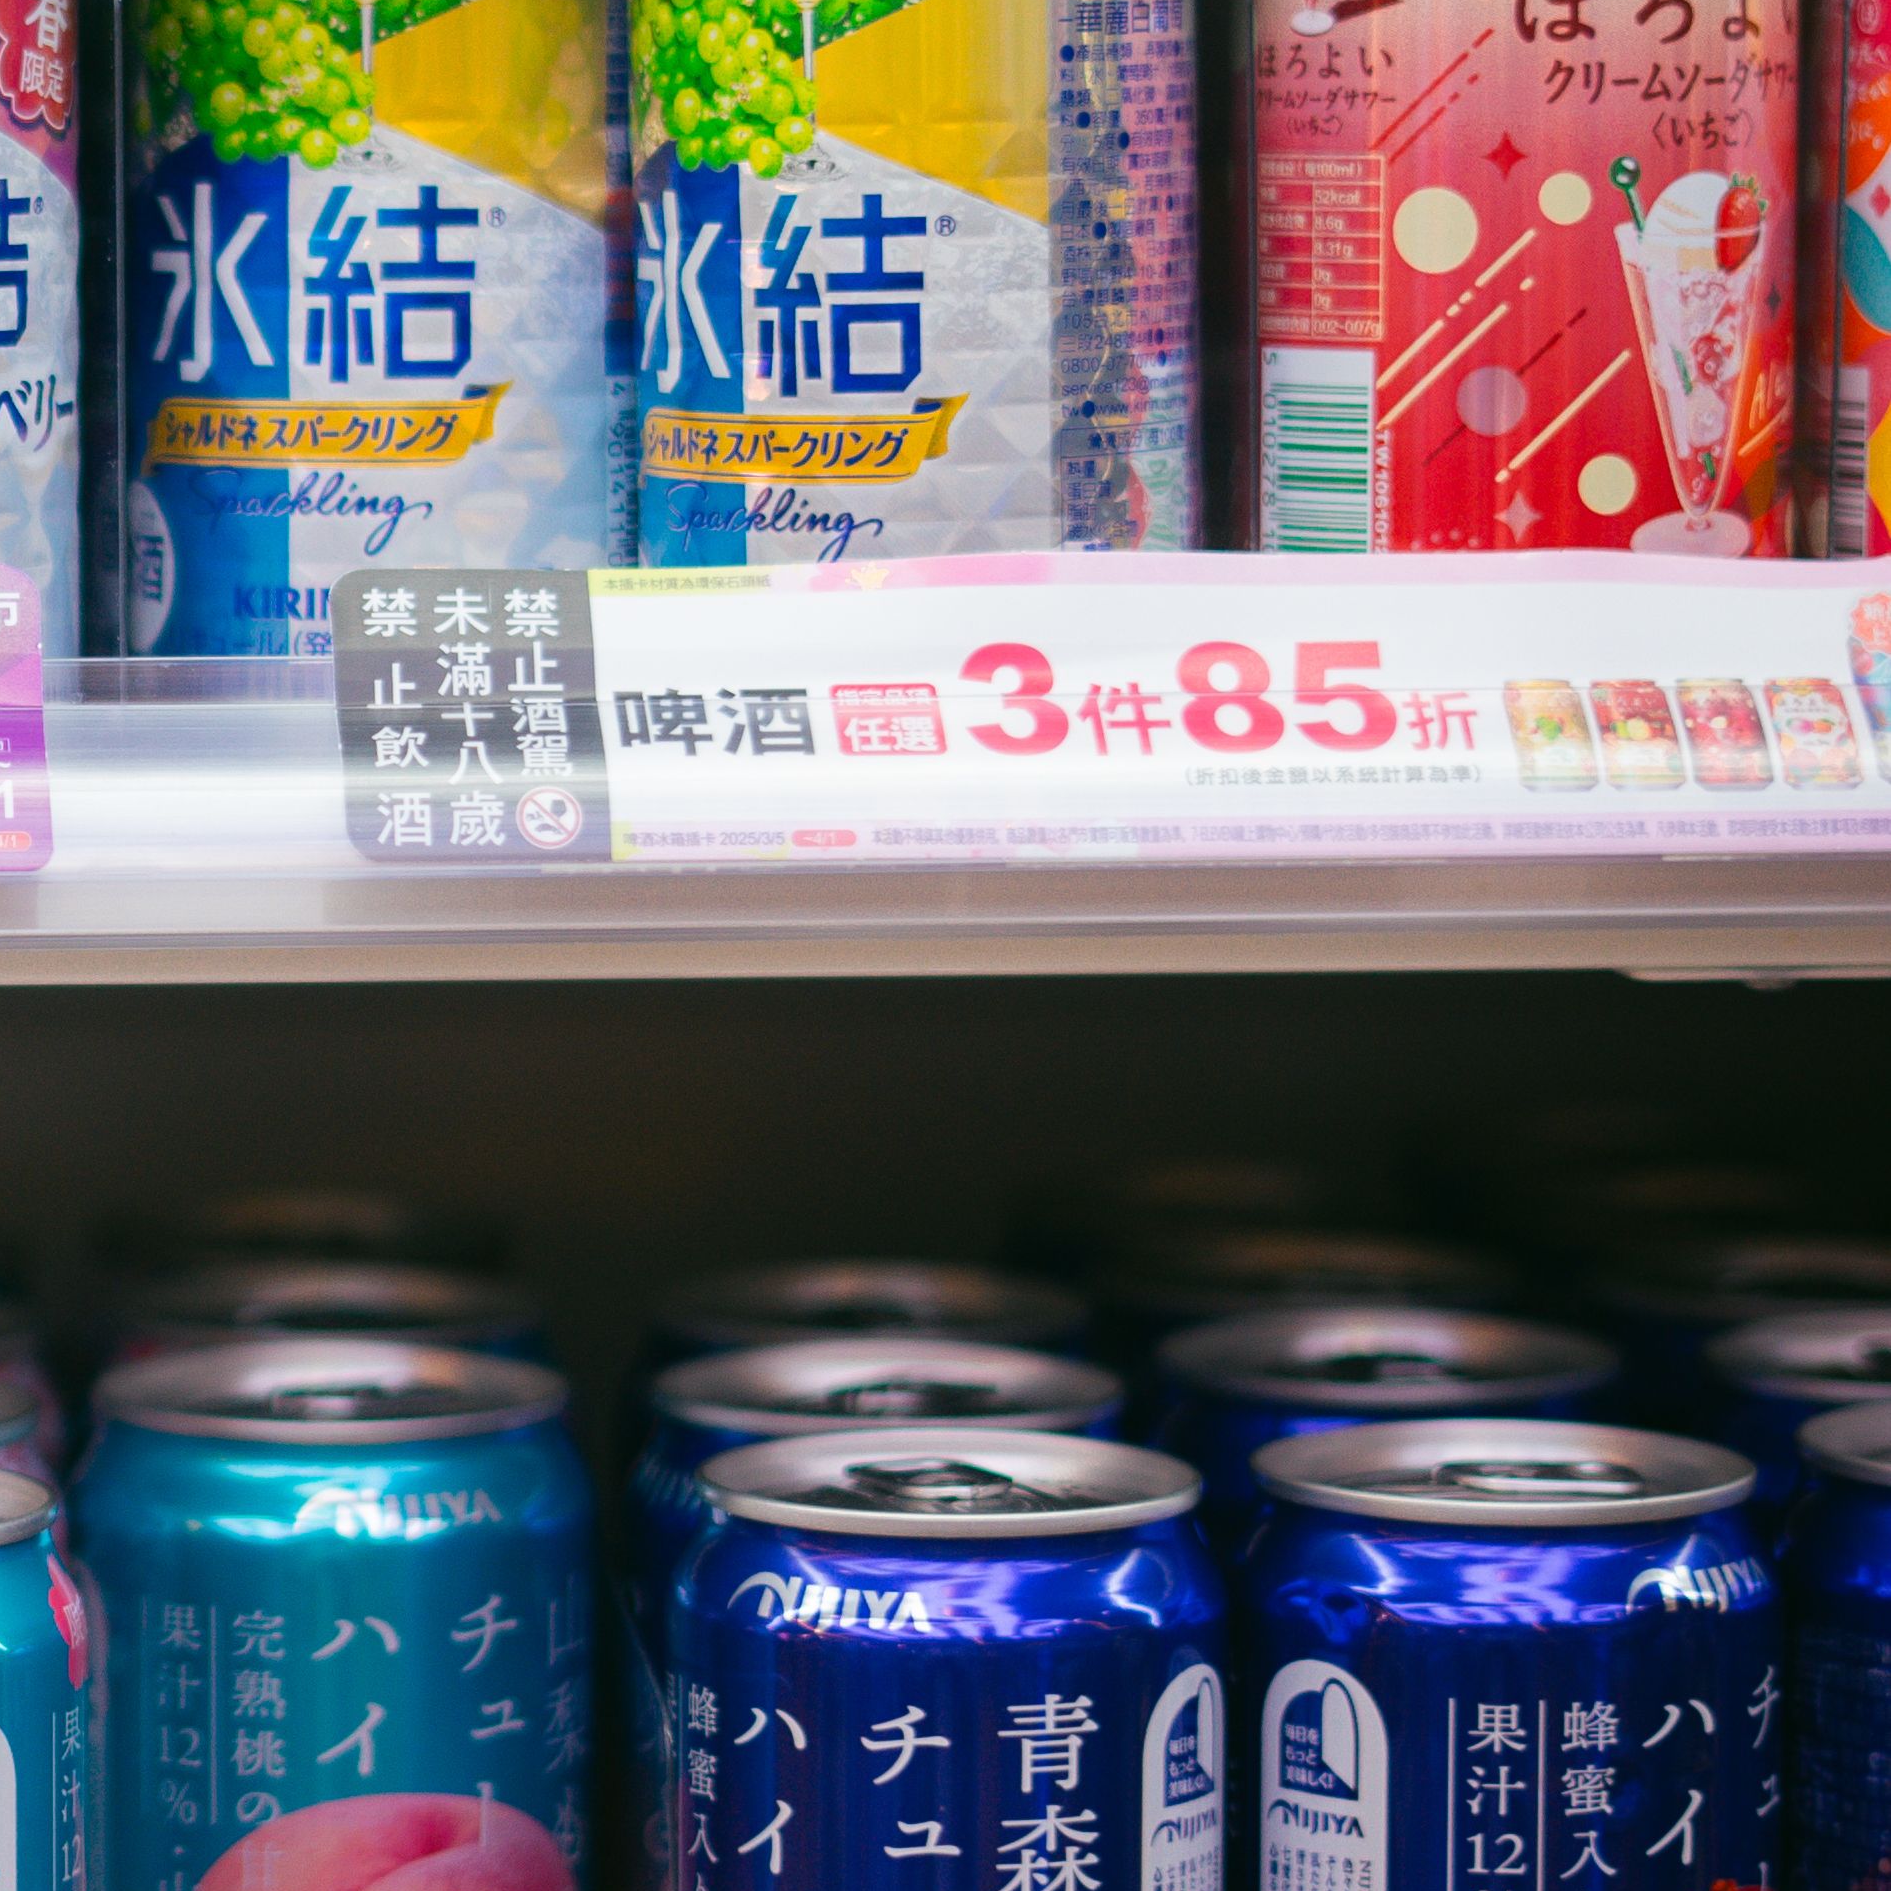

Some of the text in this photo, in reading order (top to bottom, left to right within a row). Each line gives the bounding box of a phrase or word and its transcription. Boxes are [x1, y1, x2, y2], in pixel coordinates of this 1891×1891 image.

[264, 406, 461, 456] スパークリング
[723, 426, 909, 468] スパークリング
[361, 589, 433, 849] 禁止飲酒
[433, 589, 507, 847] 未滿十八歲
[503, 589, 576, 781] 禁止酒駕
[612, 687, 817, 758] 啤酒
[844, 716, 939, 755] 任選
[957, 640, 1479, 757] 3件85折
[719, 830, 786, 847] 2025/3/5
[727, 1569, 932, 1635] NIJIYA
[310, 1613, 401, 1779] ハイ
[450, 1591, 526, 1849] チュー
[733, 1704, 809, 1877] ハイ
[1267, 1798, 1366, 1839] NIJIYA
[1641, 1698, 1719, 1868] ハイ
